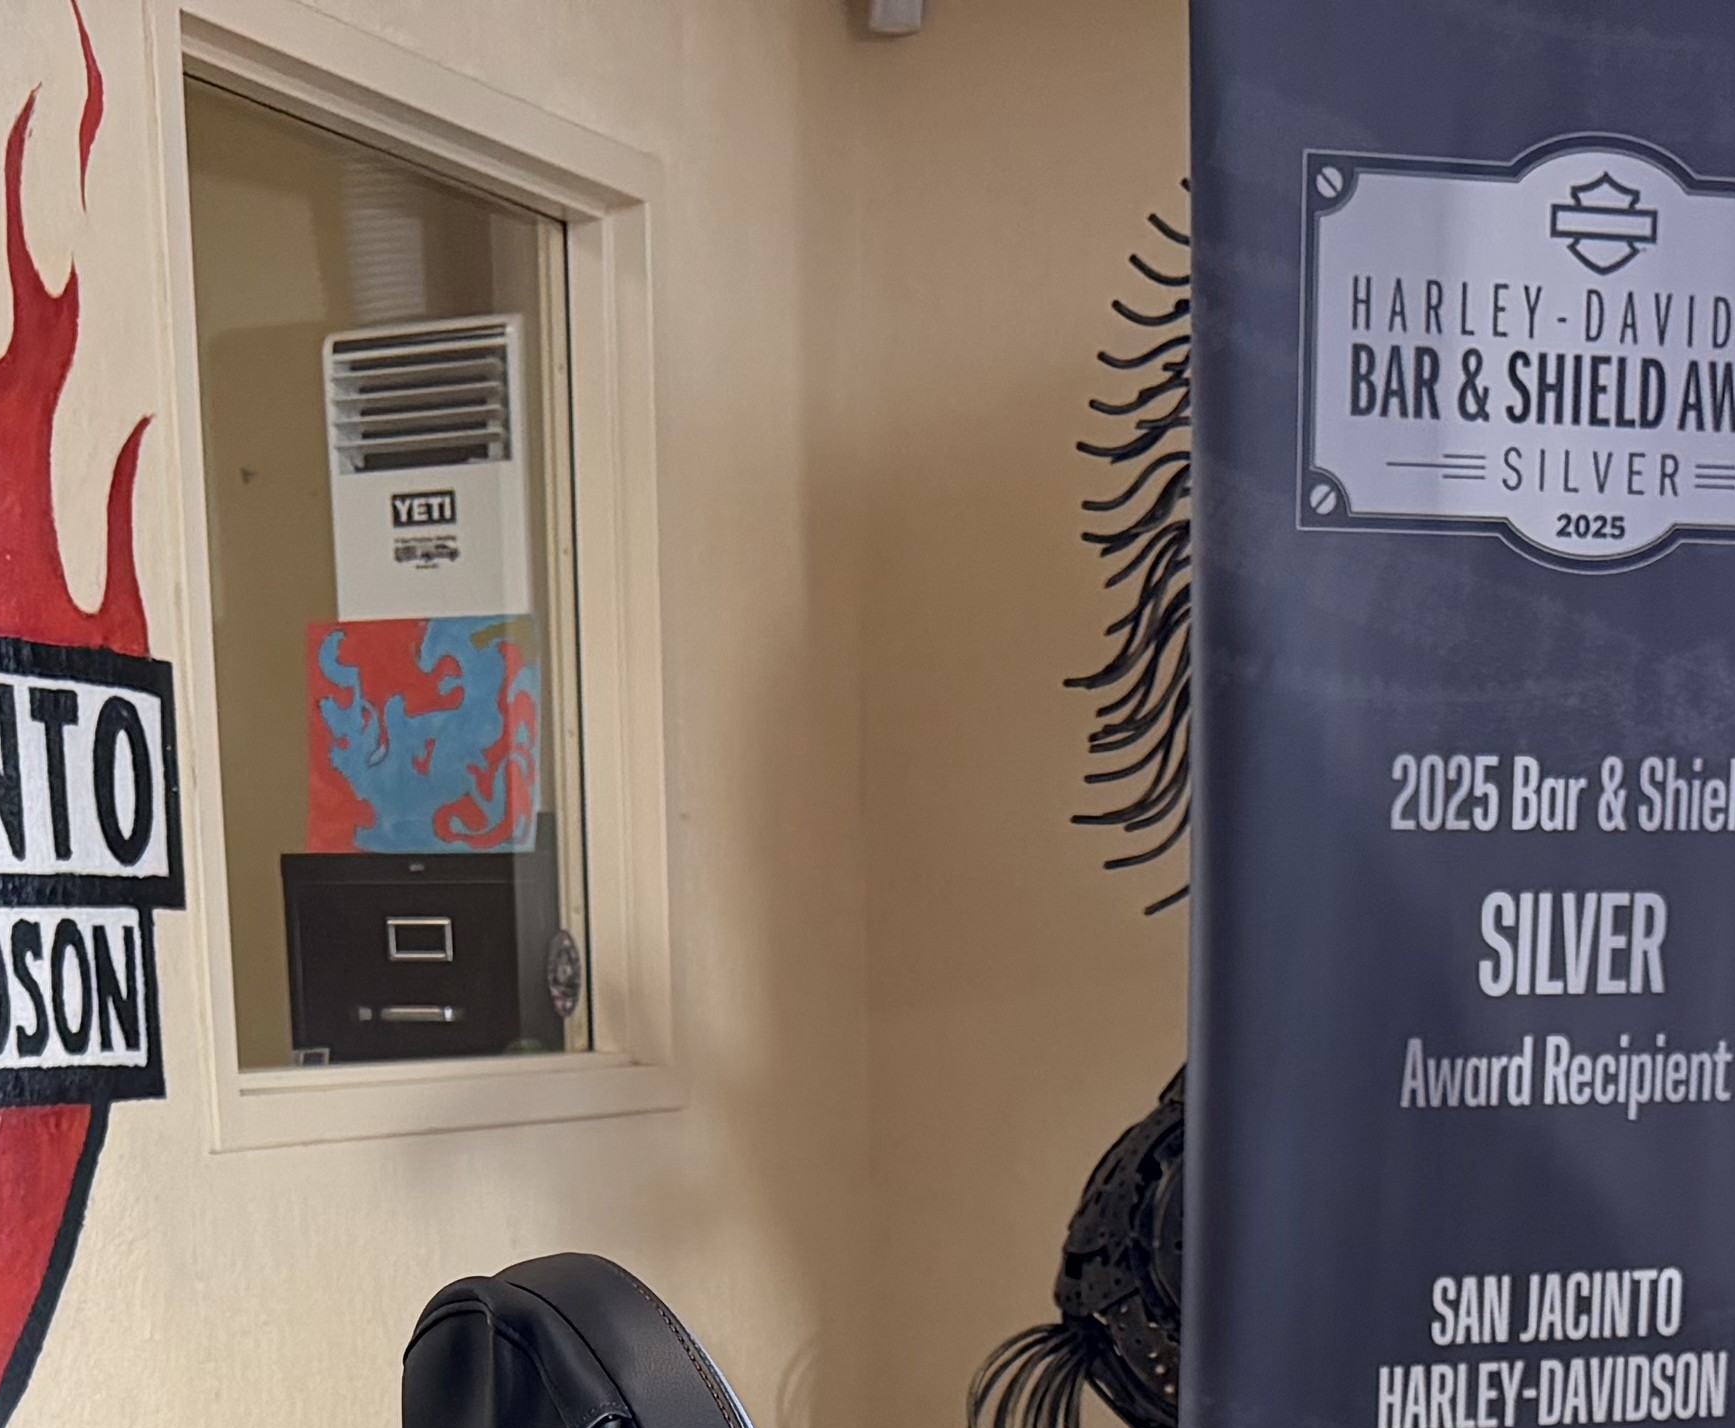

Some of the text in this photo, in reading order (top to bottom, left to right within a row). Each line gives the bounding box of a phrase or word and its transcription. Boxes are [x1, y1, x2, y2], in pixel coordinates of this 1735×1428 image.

[1349, 343, 1441, 420] BAR
[1457, 347, 1490, 423] &
[1505, 350, 1665, 429] SHIELD
[394, 496, 452, 523] YETI
[1501, 446, 1680, 497] SILVER
[1555, 513, 1626, 540] 2025
[1390, 754, 1499, 832] 2025
[1511, 756, 1587, 832] Bar
[1597, 757, 1628, 832] &
[1478, 891, 1667, 997] SILVER
[1400, 1034, 1735, 1121] Award Recipient
[1431, 1267, 1683, 1346] SAN JACINTO
